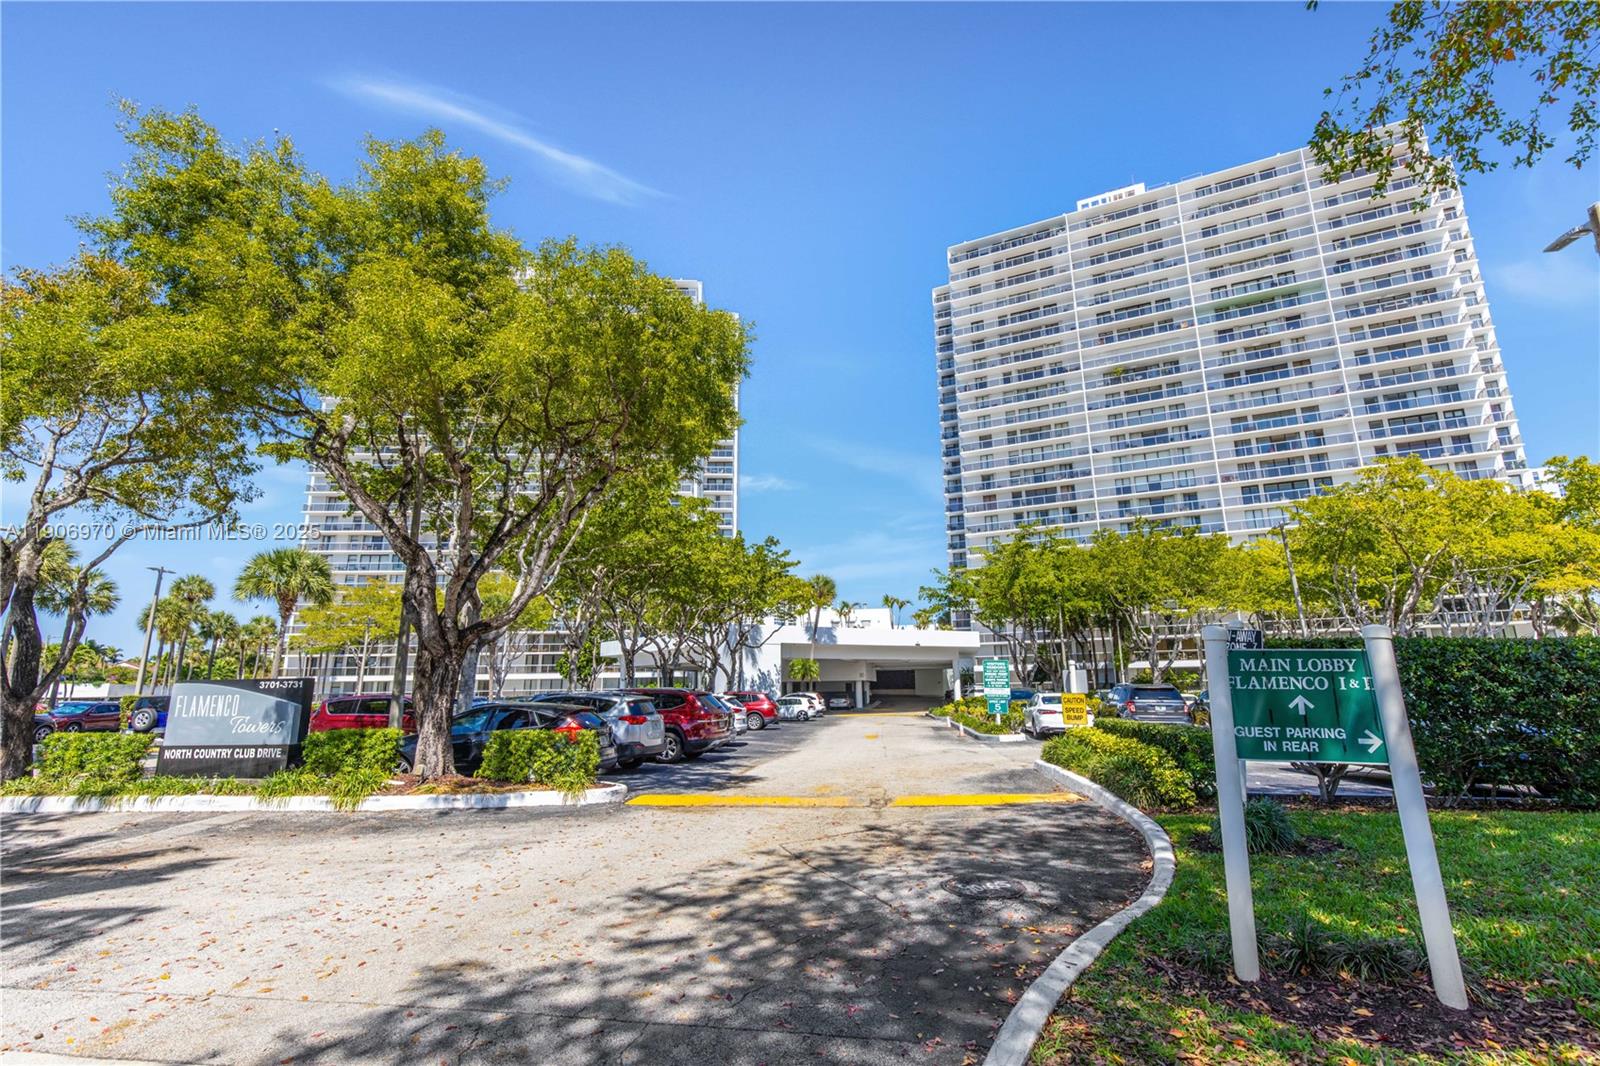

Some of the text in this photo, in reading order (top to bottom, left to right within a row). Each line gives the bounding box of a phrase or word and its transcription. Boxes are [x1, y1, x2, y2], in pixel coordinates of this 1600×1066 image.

[1226, 630, 1257, 642] W-AWAY
[1239, 658, 1357, 673] MAIN LOBBY
[259, 680, 304, 689] 3701-3731
[1227, 676, 1329, 691] FLAMENCO
[1339, 676, 1347, 691] I
[1349, 678, 1360, 689] &
[174, 694, 241, 718] FLAMENCO
[1063, 696, 1085, 704] CAUTION
[994, 703, 1002, 711] 5
[230, 715, 287, 736] Towers
[1234, 726, 1347, 740] GUEST PARKING
[1263, 740, 1319, 752] IN REAR
[163, 748, 282, 760] NORTH COUNTRY CLUB DRIVE
